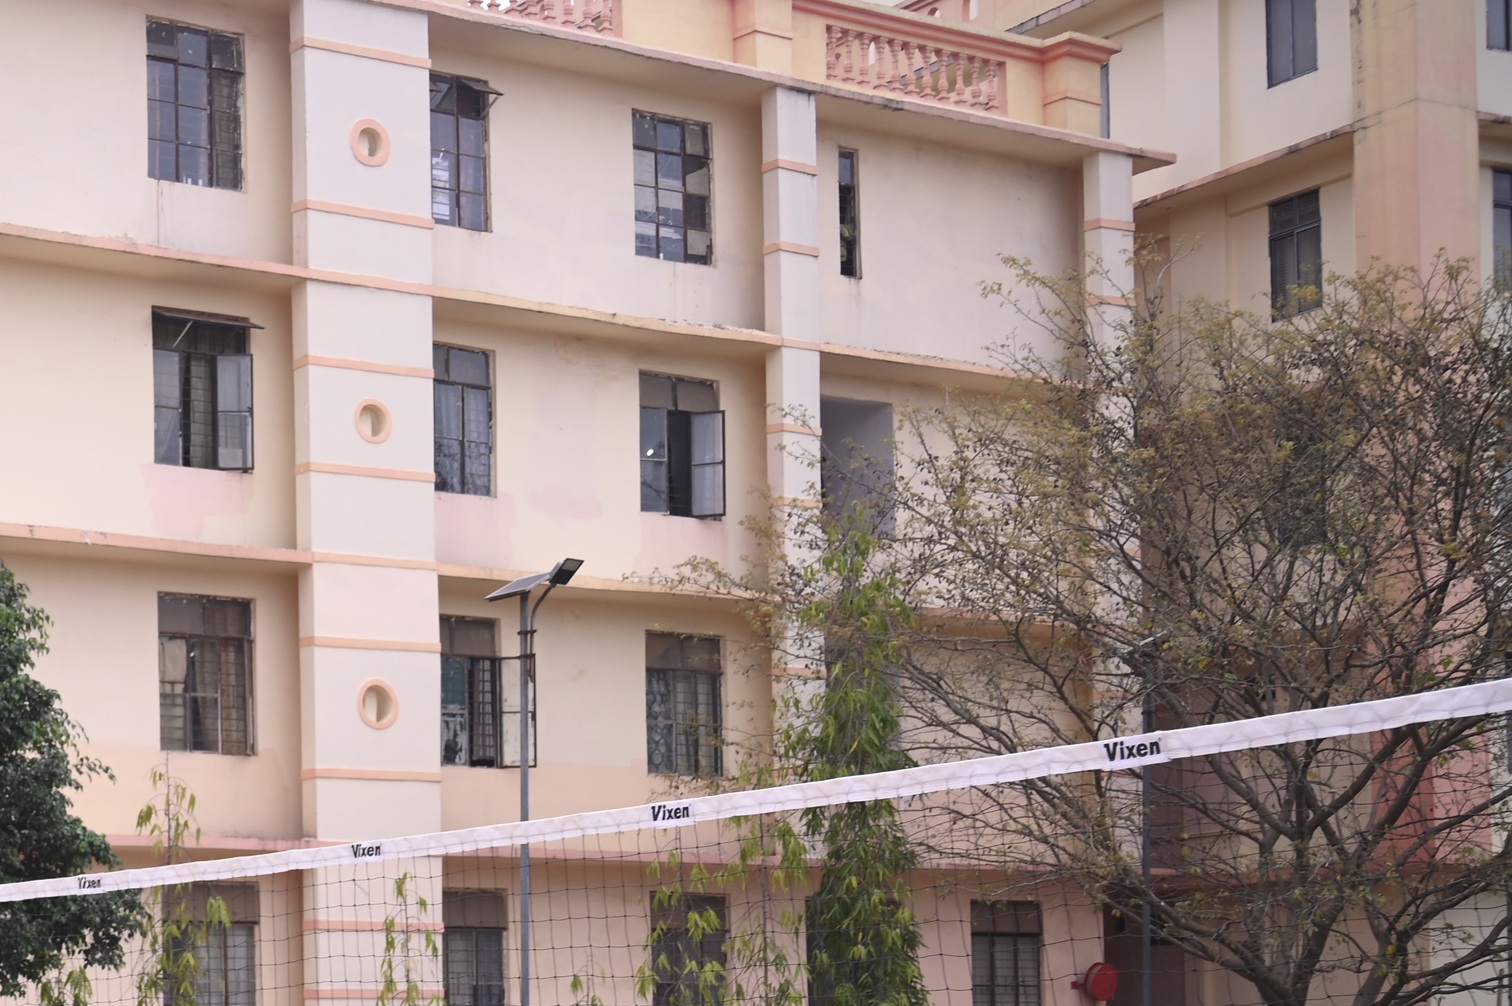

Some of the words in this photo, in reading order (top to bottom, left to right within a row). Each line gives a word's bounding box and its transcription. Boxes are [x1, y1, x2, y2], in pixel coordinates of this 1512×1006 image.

[1103, 738, 1161, 763] Vixen
[651, 804, 690, 822] Vixen
[351, 843, 381, 858] Vixen
[77, 876, 102, 889] Vixen
